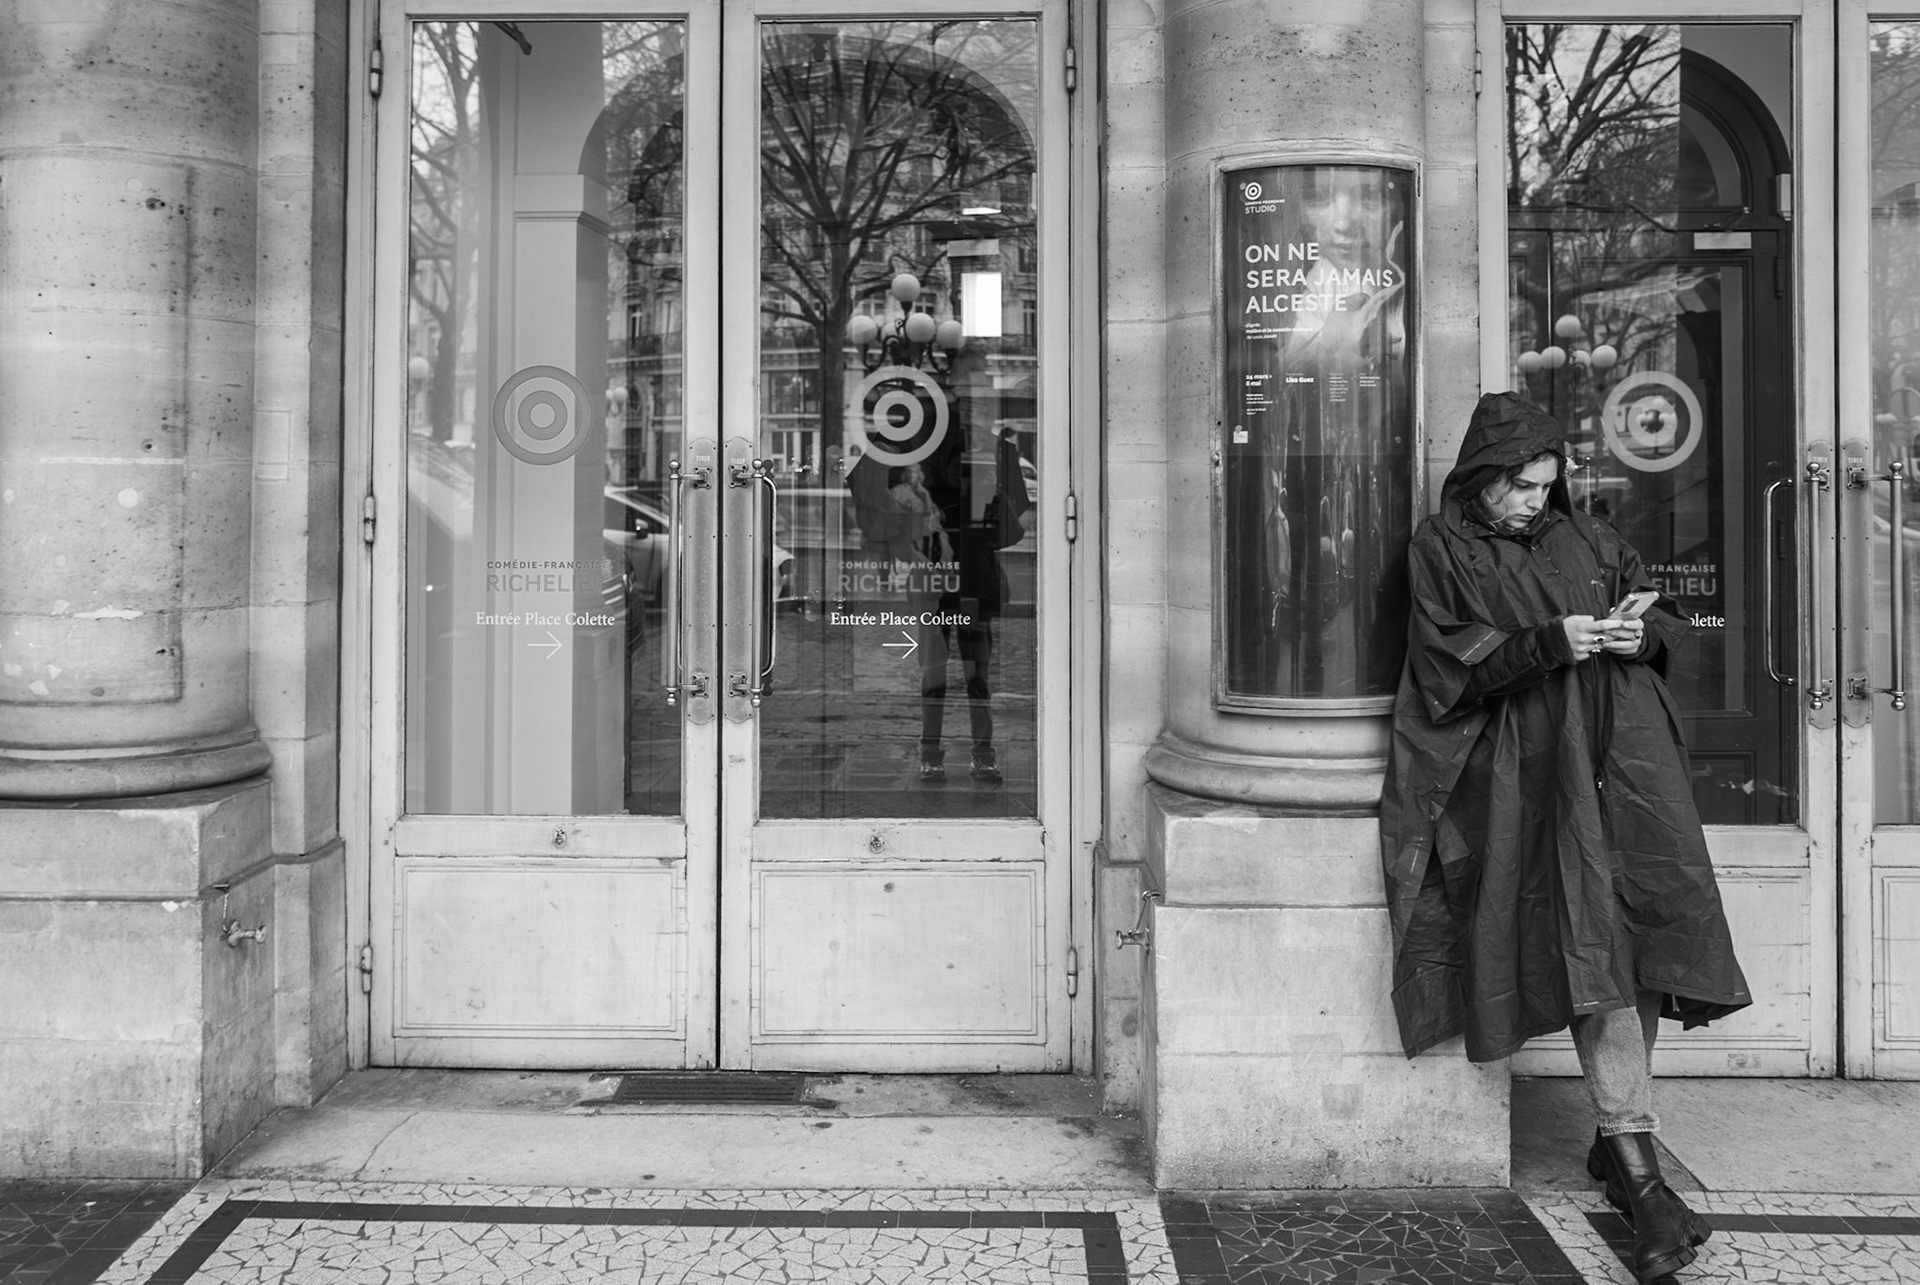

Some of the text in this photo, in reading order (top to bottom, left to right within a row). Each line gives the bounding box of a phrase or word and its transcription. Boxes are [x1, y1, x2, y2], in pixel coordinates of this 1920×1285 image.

[1245, 204, 1277, 214] STUDIO
[1245, 242, 1320, 263] ON NE
[1246, 267, 1394, 289] SERA JAMAIS
[1245, 293, 1348, 314] ALCESTE
[487, 558, 609, 570] COMÉDIE-FRANÇAISE
[838, 559, 961, 571] COMÉDIE-FRANÇAISE
[1641, 564, 1716, 575] -FRANÇAISE
[838, 574, 961, 593] RICHELIEU
[1651, 577, 1717, 596] ELIEU
[475, 611, 616, 626] Entrée Place Colette
[830, 611, 971, 626] Entrée Place Colette
[1690, 613, 1725, 627] lette
